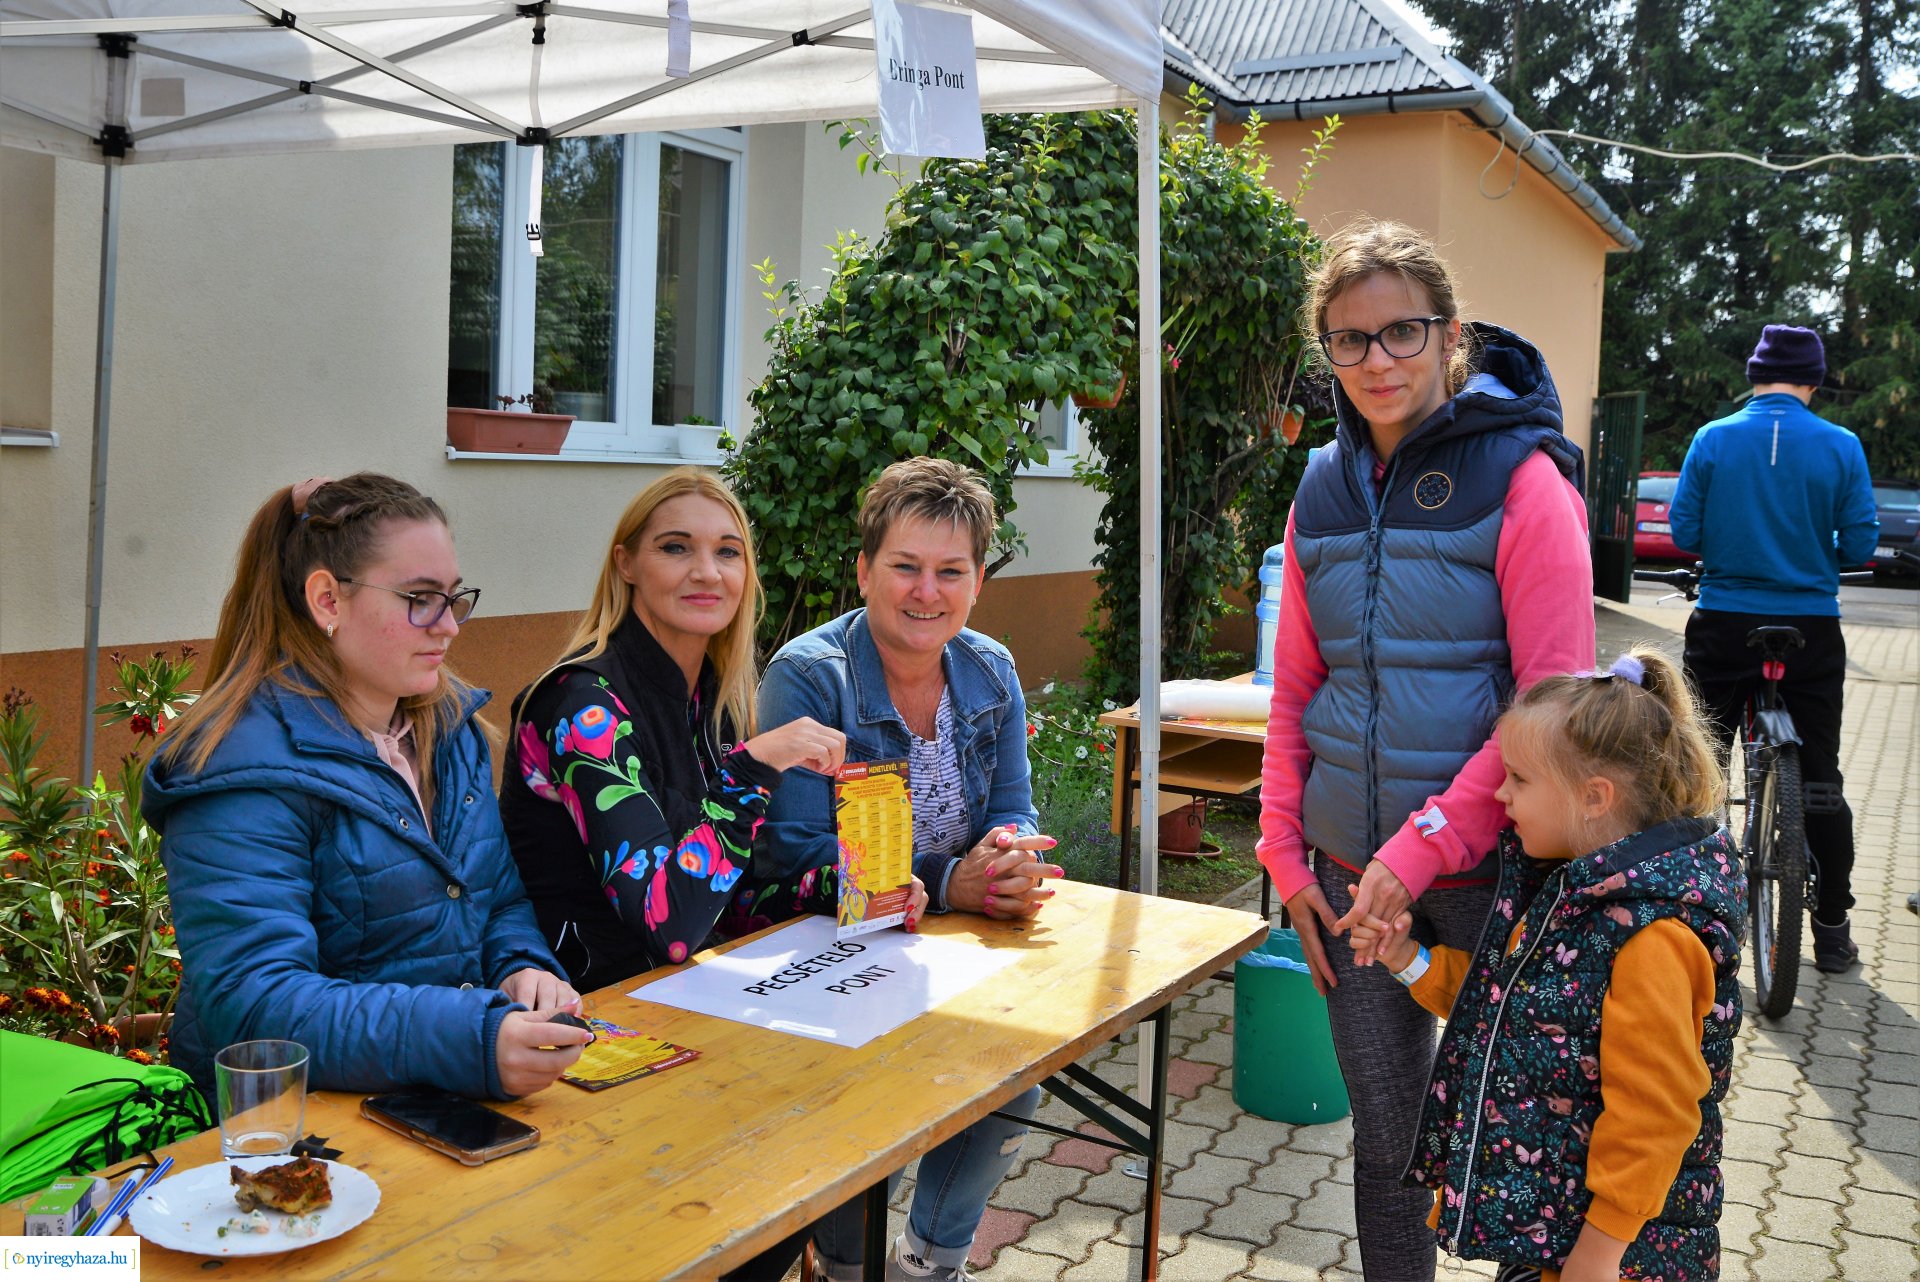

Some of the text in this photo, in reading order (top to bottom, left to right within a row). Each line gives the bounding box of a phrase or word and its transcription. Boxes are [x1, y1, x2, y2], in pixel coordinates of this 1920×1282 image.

[889, 58, 965, 91] Bringa Pont
[742, 940, 867, 996] PECSÉTELŐ
[825, 964, 897, 995] PONT
